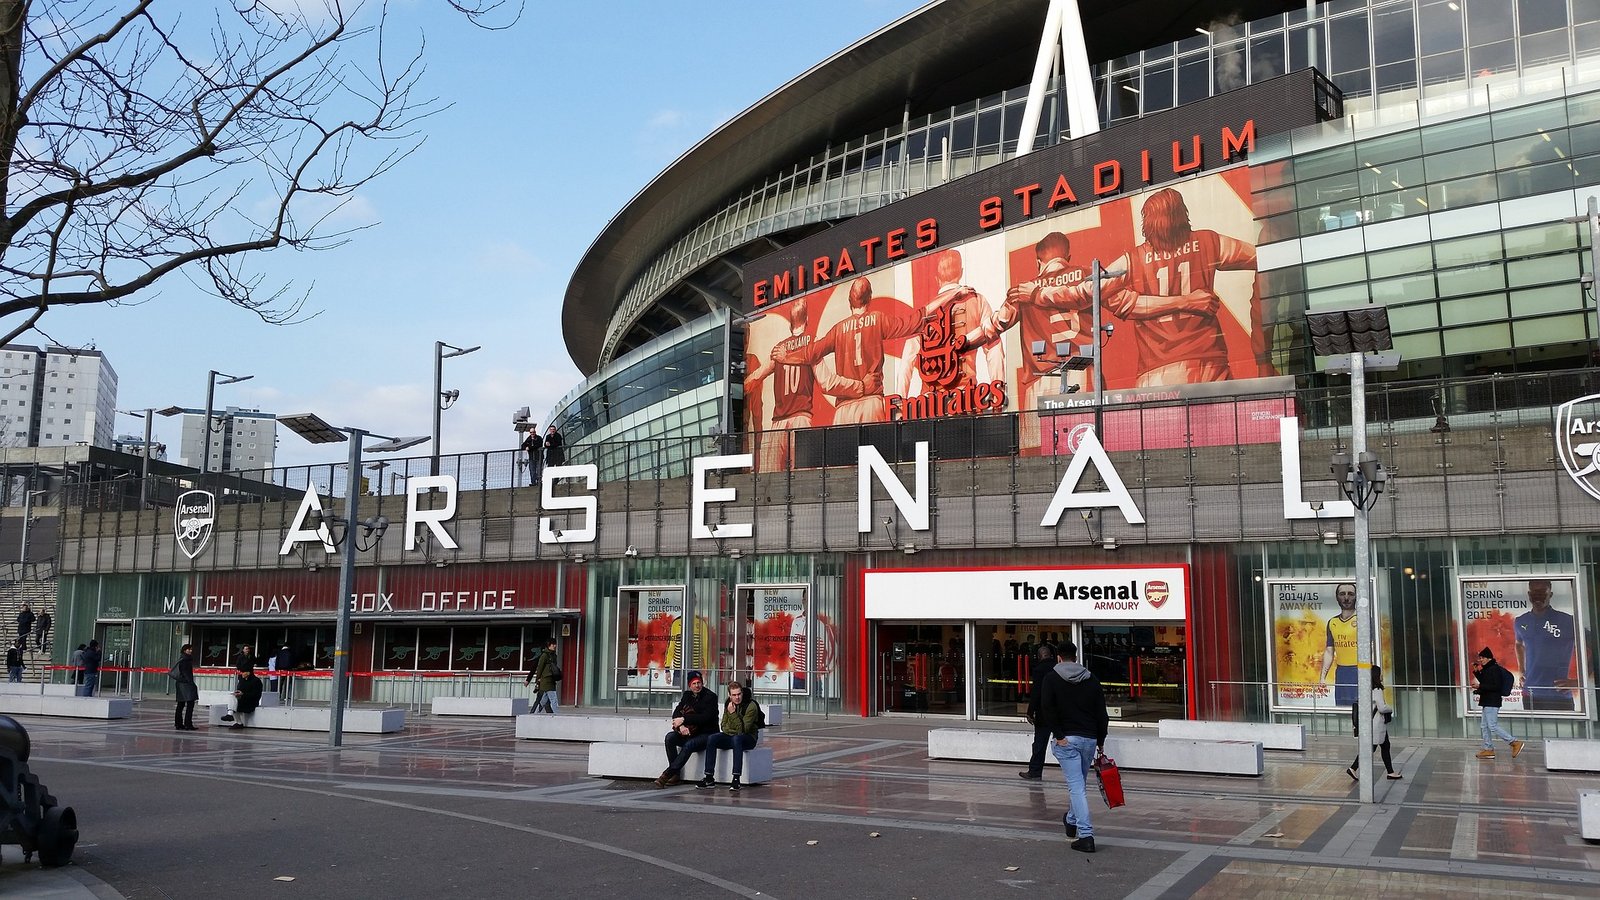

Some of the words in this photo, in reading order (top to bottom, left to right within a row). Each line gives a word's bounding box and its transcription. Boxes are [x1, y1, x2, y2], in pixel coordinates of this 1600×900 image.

[753, 218, 938, 307] EMIRATES
[979, 119, 1255, 229] STADIUM
[842, 314, 876, 334] WILSON
[854, 332, 862, 366] 1
[783, 364, 801, 396] 10
[884, 378, 1006, 421] Emirates
[1044, 400, 1064, 410] The
[1066, 395, 1109, 408] Arsenl
[1126, 390, 1181, 402] MATCHDAY
[279, 416, 1355, 556] ARSENAL
[181, 503, 210, 515] Arsenal
[1010, 581, 1048, 600] The
[1054, 580, 1139, 600] Arsenal
[1279, 592, 1319, 602] 2014/15
[1466, 590, 1503, 599] SPRING
[163, 595, 233, 613] MATCH
[252, 595, 295, 612] DAY
[421, 590, 515, 611] OFFICE
[1094, 602, 1140, 610] ARMOURY
[1307, 602, 1322, 610] KIT
[1467, 600, 1527, 609] COLLECTION
[1467, 611, 1492, 620] 2015
[1542, 620, 1561, 638] AFC
